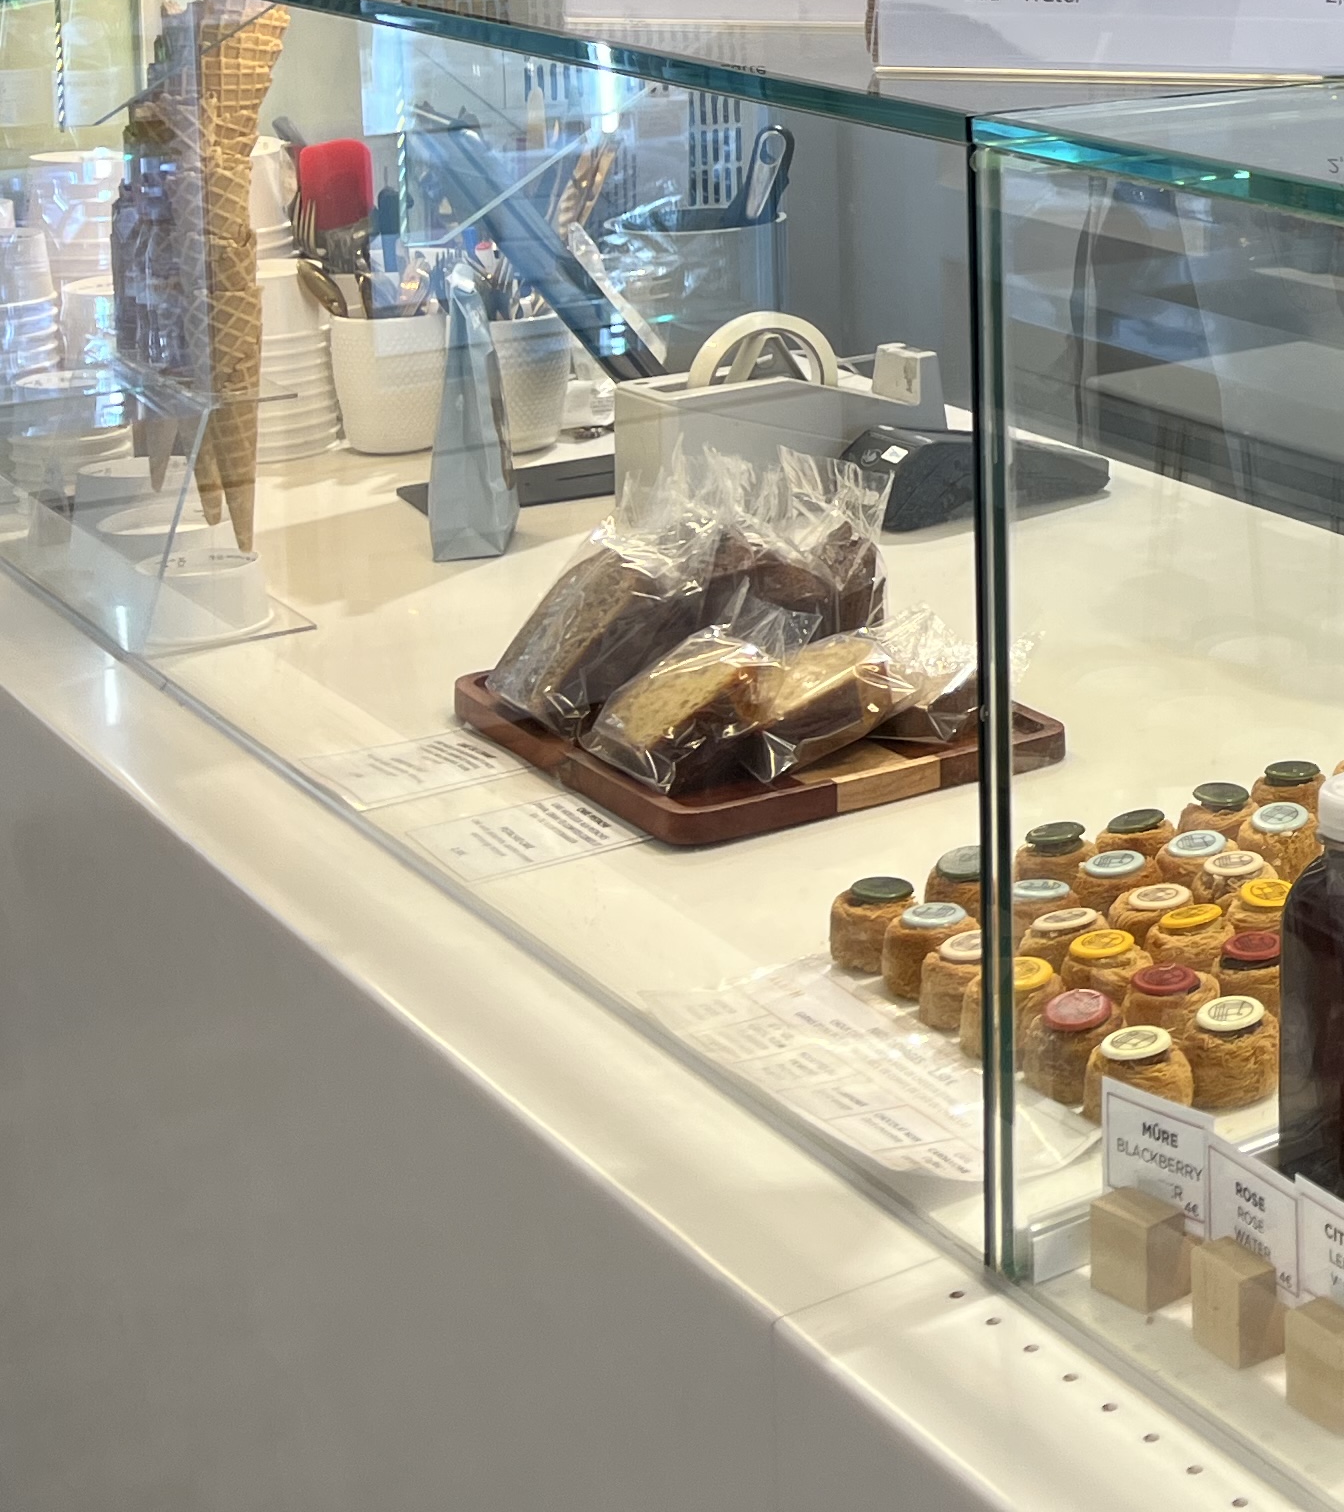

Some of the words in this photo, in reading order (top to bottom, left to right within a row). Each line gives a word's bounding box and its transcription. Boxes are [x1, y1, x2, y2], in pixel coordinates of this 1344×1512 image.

[1142, 1121, 1178, 1148] MÛRE
[1116, 1138, 1204, 1182] BLACKBERRY
[1235, 1181, 1266, 1212] ROSE
[1238, 1206, 1264, 1234] ROSE
